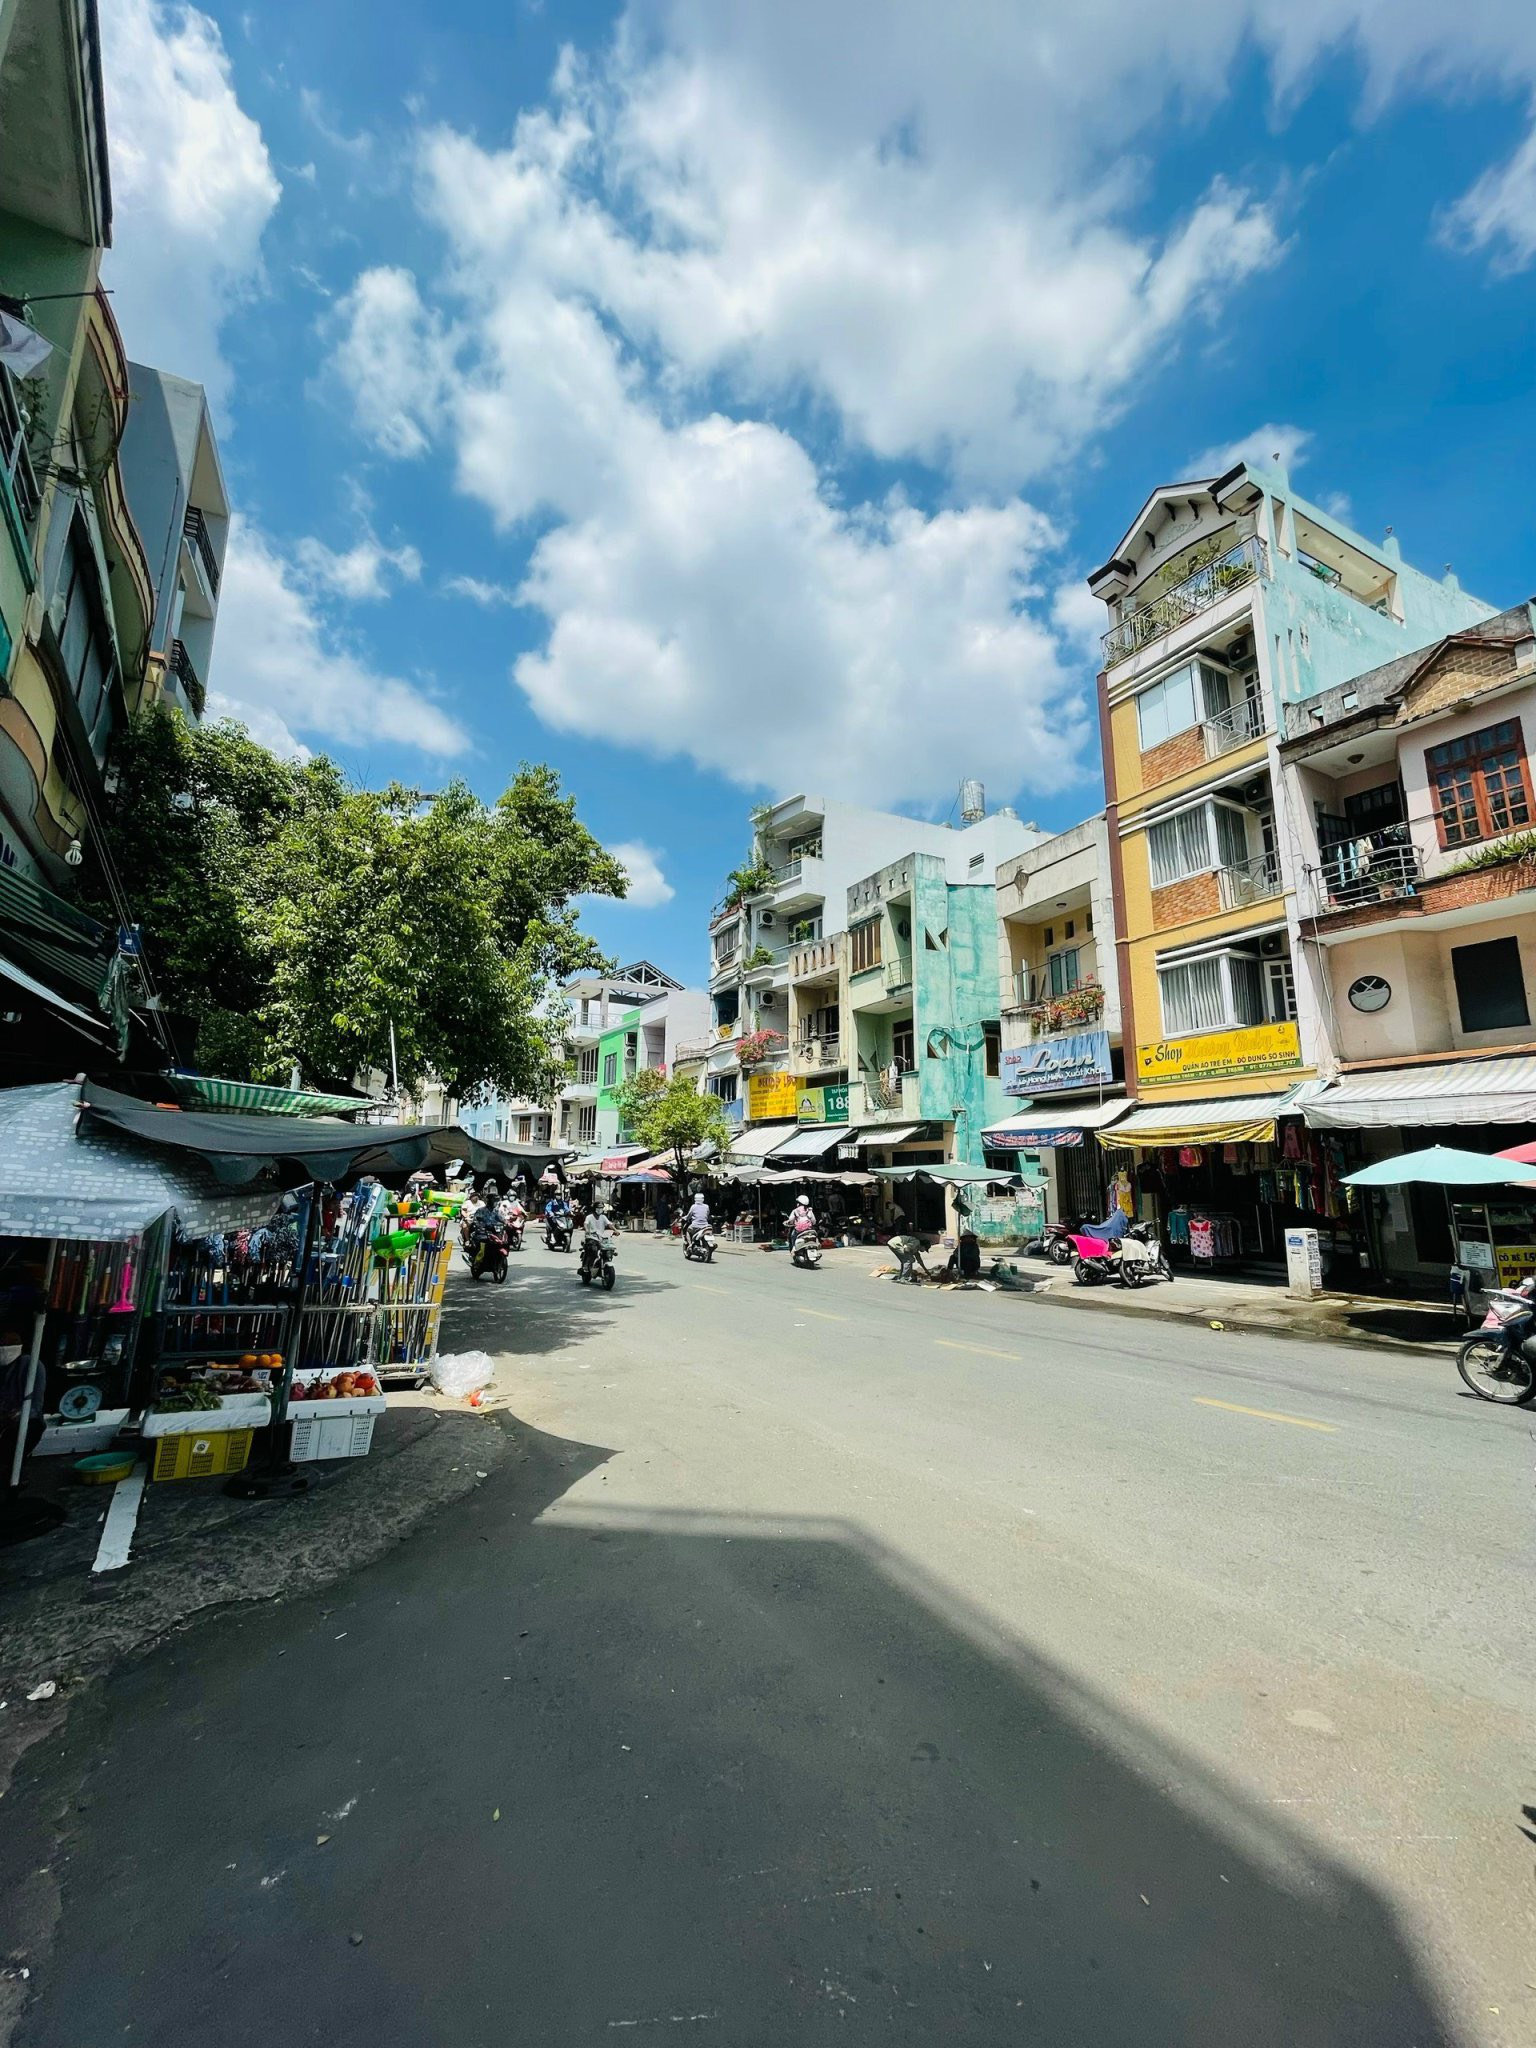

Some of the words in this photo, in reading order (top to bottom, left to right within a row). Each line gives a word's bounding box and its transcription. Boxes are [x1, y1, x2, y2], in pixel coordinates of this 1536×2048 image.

[1016, 1048, 1096, 1076] Loan
[1155, 1044, 1182, 1063] Shop
[1278, 1049, 1296, 1058] SINH
